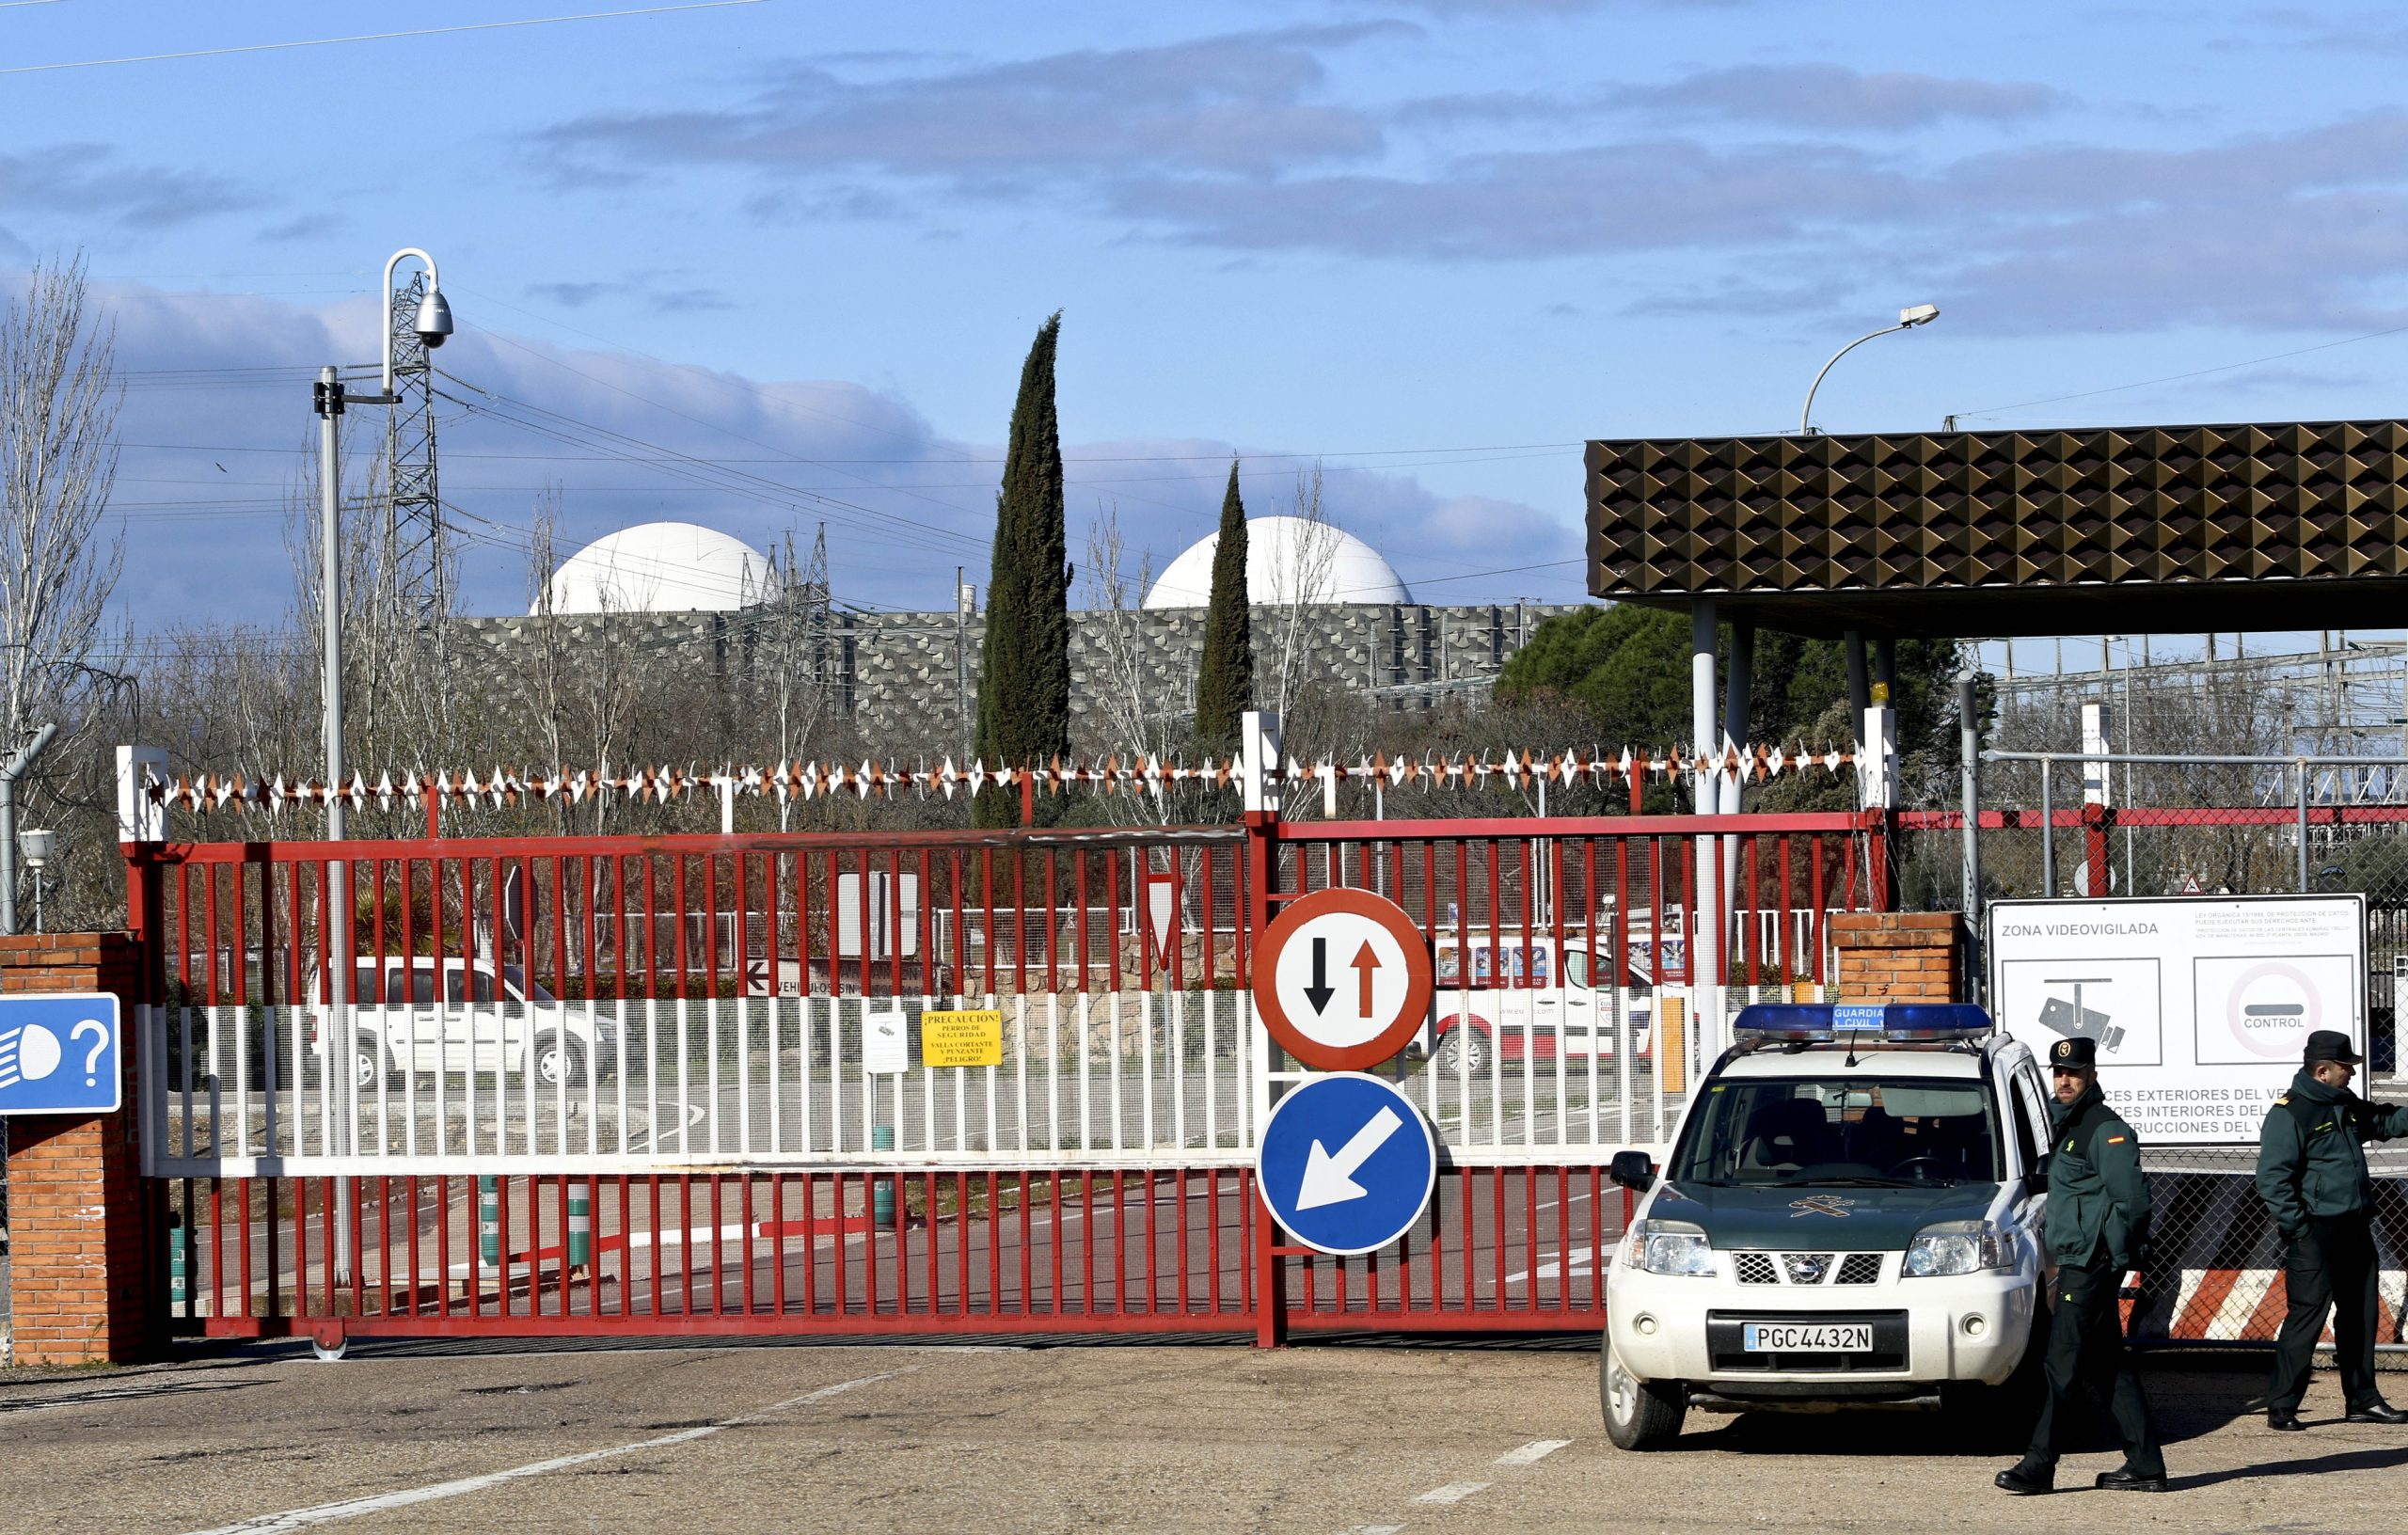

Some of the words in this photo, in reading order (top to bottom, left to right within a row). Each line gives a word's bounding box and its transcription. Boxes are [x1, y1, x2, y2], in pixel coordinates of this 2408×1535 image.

[2002, 925, 2042, 937] ZONA
[2046, 923, 2159, 936] VIDEOVIGILADA
[777, 981, 832, 993] VEHIULOS
[838, 982, 855, 994] SIN
[924, 1011, 999, 1026] ¡PRECAUCIÓN!
[1834, 1008, 1884, 1018] GUARDIA
[1845, 1018, 1870, 1026] CIVIL
[2244, 1018, 2305, 1028] CONTROL
[943, 1055, 982, 1064] ¡PELIGRO!
[2137, 1089, 2230, 1101] EXTERIORES
[2234, 1088, 2263, 1100] DEL
[2147, 1105, 2235, 1117] INTERIORES
[2239, 1104, 2267, 1116] DEL
[2224, 1120, 2253, 1132] DEL
[1757, 1327, 1870, 1349] PGC4432N
